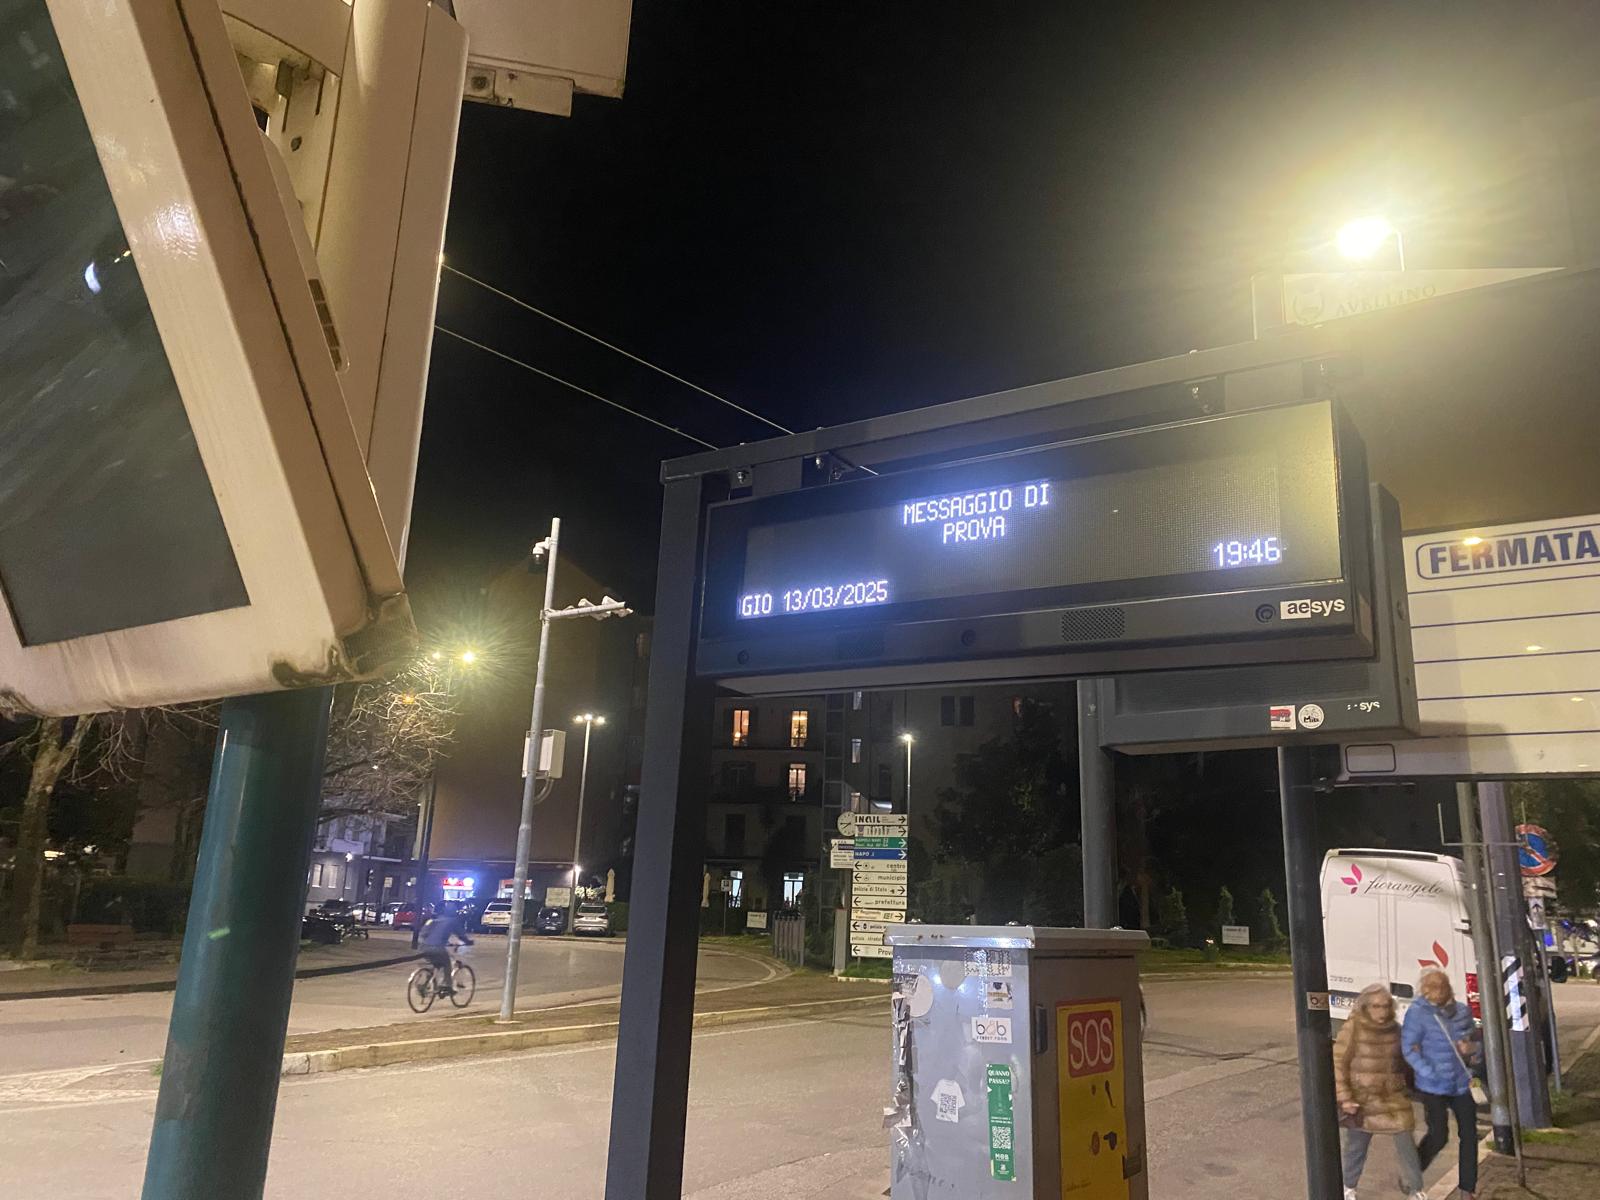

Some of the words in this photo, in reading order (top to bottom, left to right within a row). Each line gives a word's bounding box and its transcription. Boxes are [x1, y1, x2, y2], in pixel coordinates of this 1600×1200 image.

[904, 489, 1012, 525] MESSAGGIO
[1024, 483, 1049, 508] DI
[943, 516, 1005, 544] PROVA
[1213, 537, 1280, 567] 19:46
[1429, 530, 1600, 575] FERMATA
[742, 593, 772, 616] GIO
[783, 580, 888, 612] 13/03/2025
[1287, 599, 1345, 616] aesys
[1364, 874, 1443, 898] fiorangelo
[1069, 1018, 1113, 1070] SOS
